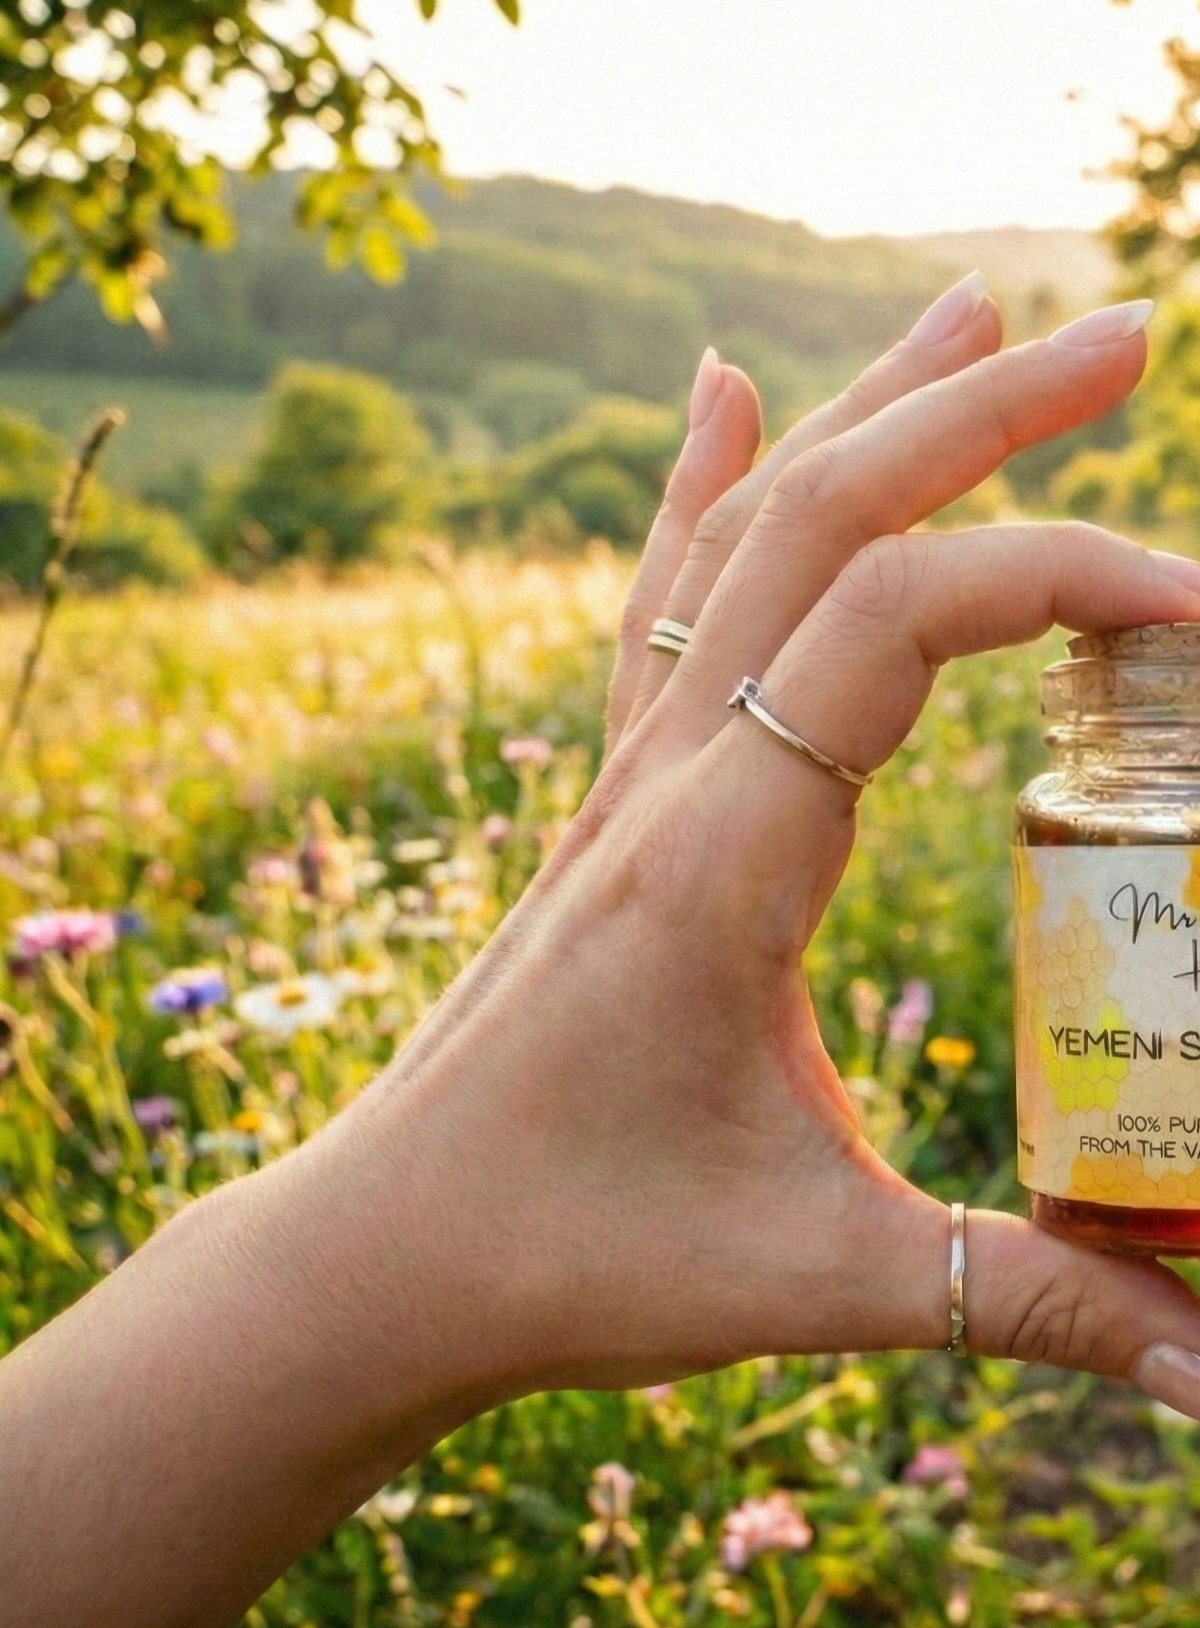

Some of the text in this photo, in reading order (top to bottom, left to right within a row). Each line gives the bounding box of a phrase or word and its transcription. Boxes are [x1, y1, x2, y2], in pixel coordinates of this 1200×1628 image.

[1109, 883, 1197, 944] Mr
[1049, 1026, 1163, 1060] YEMENI
[1117, 1114, 1161, 1134] 100%
[1080, 1136, 1130, 1156] FROM
[1137, 1139, 1176, 1159] THE
